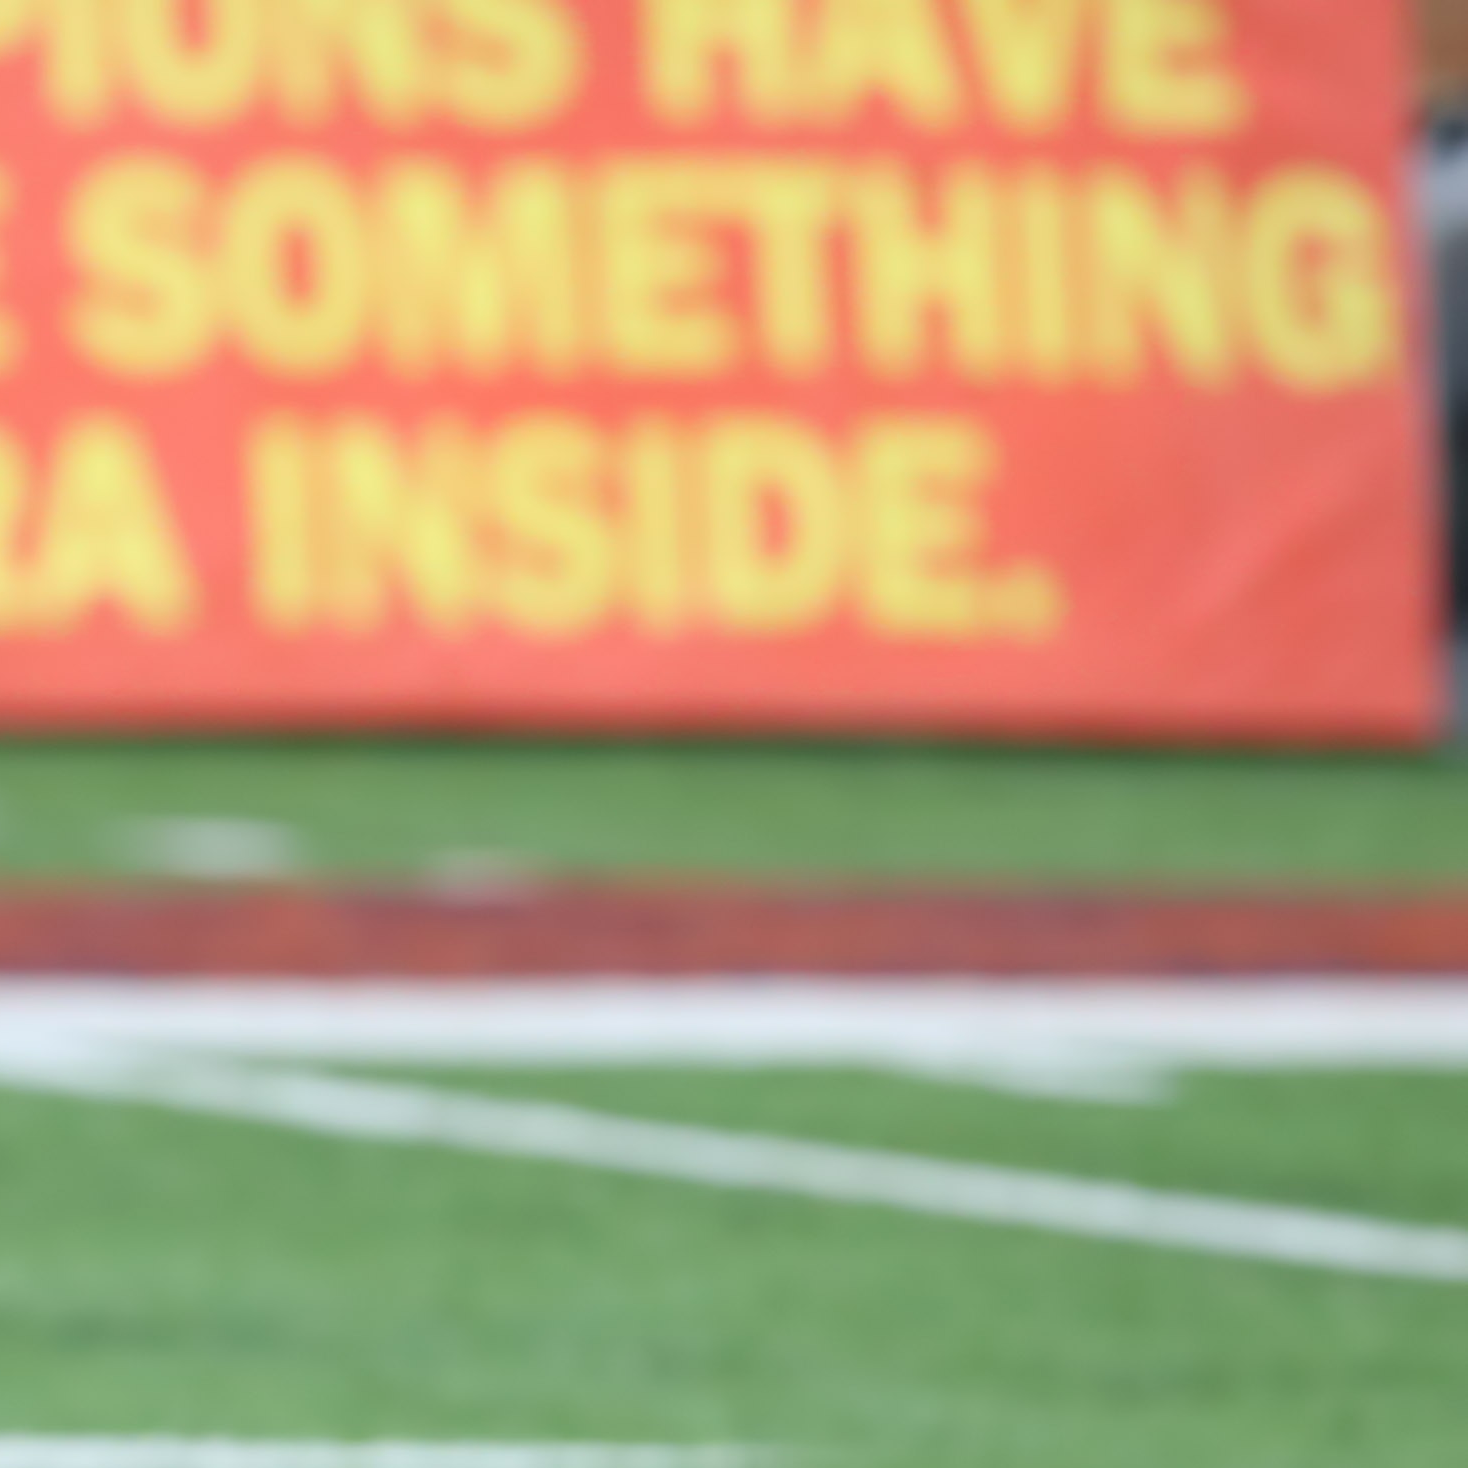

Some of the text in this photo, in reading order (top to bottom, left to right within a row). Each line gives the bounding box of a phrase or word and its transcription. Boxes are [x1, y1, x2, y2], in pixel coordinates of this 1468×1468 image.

[645, 0, 1237, 130] HAVE
[65, 156, 1393, 390] SOMETHING
[249, 416, 1057, 640] INSIDE.
